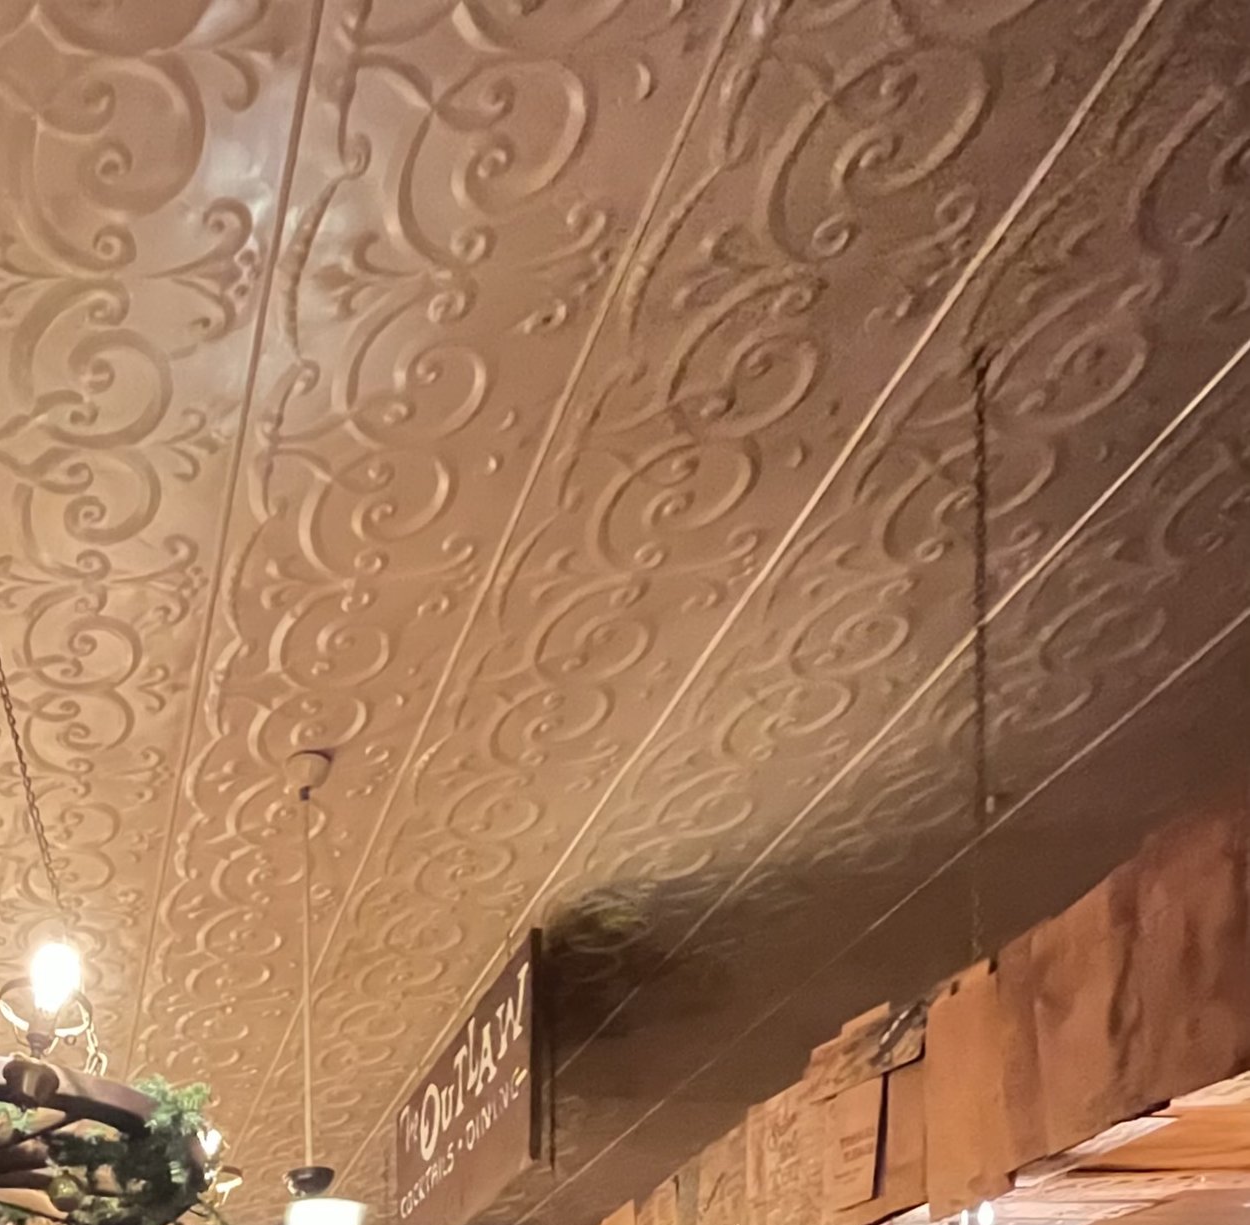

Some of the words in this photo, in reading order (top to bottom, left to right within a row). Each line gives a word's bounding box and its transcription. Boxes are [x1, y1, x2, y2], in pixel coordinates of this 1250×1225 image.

[400, 1142, 454, 1219] COCKTAILS
[466, 1066, 528, 1151] DINING
[419, 961, 529, 1162] OUTLAW
